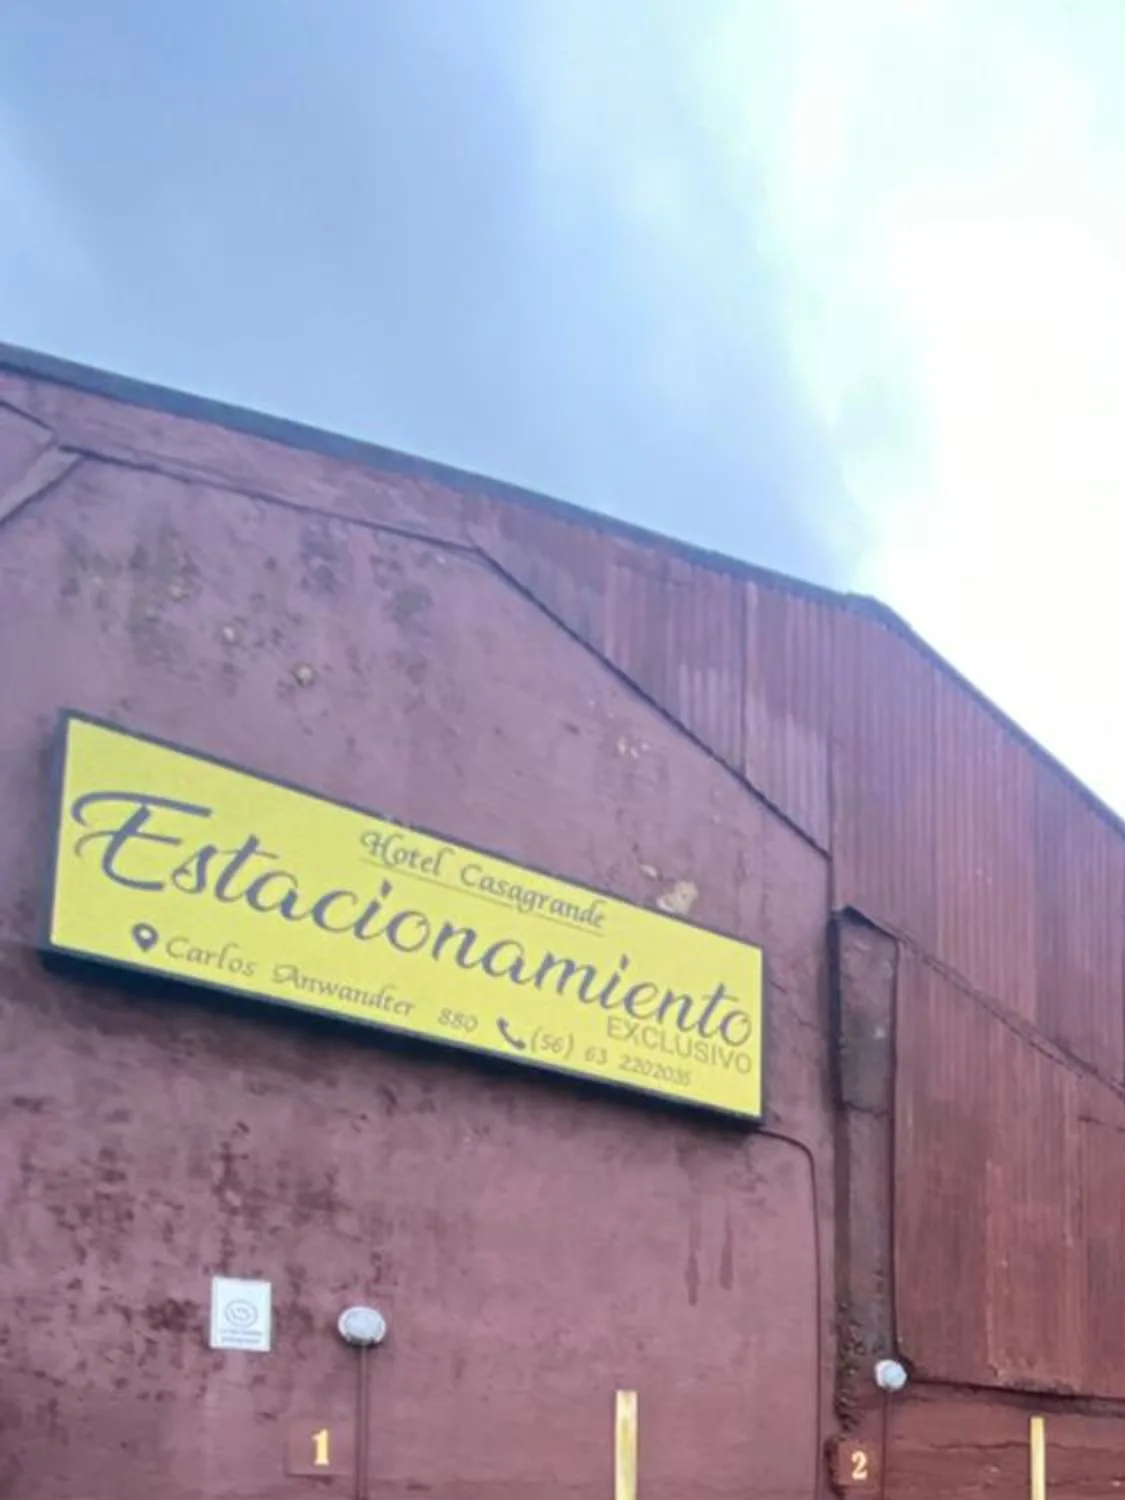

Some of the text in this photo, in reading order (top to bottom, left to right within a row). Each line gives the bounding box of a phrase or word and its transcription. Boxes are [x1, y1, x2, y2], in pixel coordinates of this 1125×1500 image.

[360, 831, 607, 929] Hotel Casagrande
[71, 790, 752, 1047] Estacionamiento
[165, 935, 478, 1033] Carlos Anwandter 880
[528, 1025, 575, 1061] (56)
[606, 1015, 752, 1075] EXCLUSIVO
[312, 1428, 330, 1466] 1
[850, 1450, 868, 1481] 2
